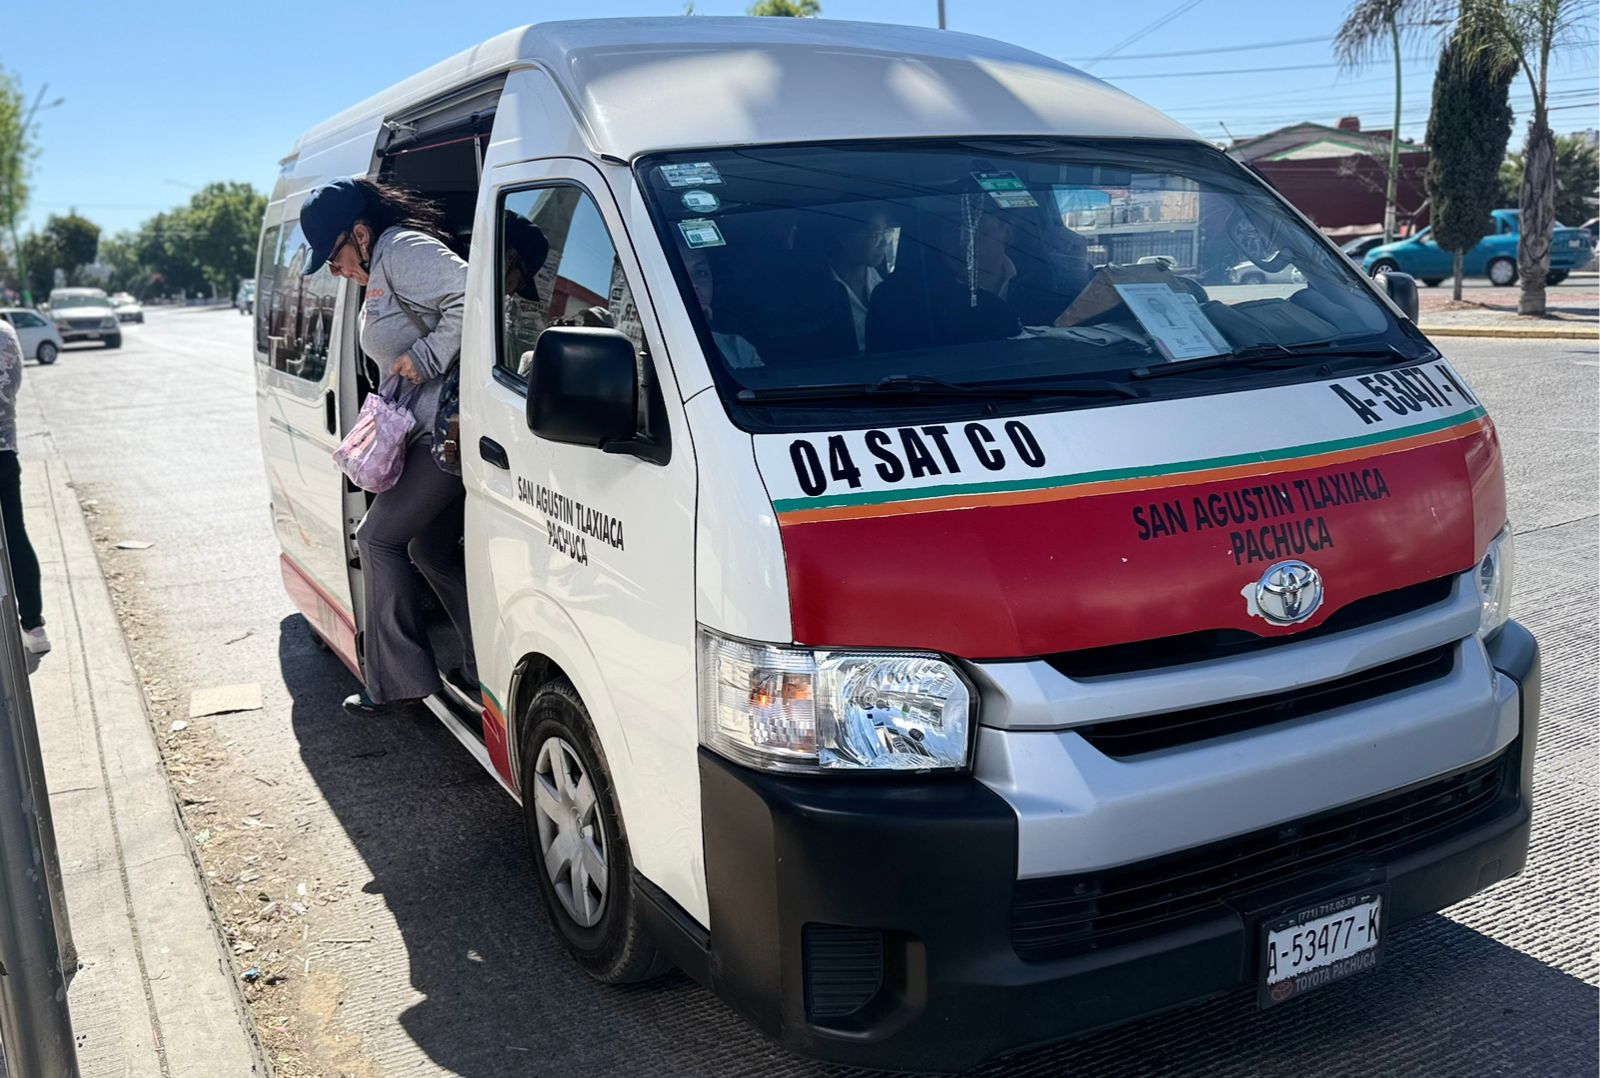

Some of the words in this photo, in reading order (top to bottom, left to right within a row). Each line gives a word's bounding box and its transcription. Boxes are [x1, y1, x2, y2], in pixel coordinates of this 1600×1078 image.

[789, 439, 862, 496] 04
[864, 425, 961, 483] SAT
[518, 476, 534, 507] SAN
[536, 484, 574, 526] AGUSTIN
[575, 502, 625, 551] TLAXIACA
[1132, 499, 1188, 540] SAN
[1195, 482, 1294, 531] AGUSTIN
[1294, 468, 1391, 512] TLAXIACA
[546, 520, 588, 566] PACHUCA
[1229, 516, 1334, 566] PACHUCA
[1268, 907, 1378, 976] A-53477-K
[1295, 970, 1330, 993] TOYOTA
[1332, 952, 1376, 979] PACHUCA
